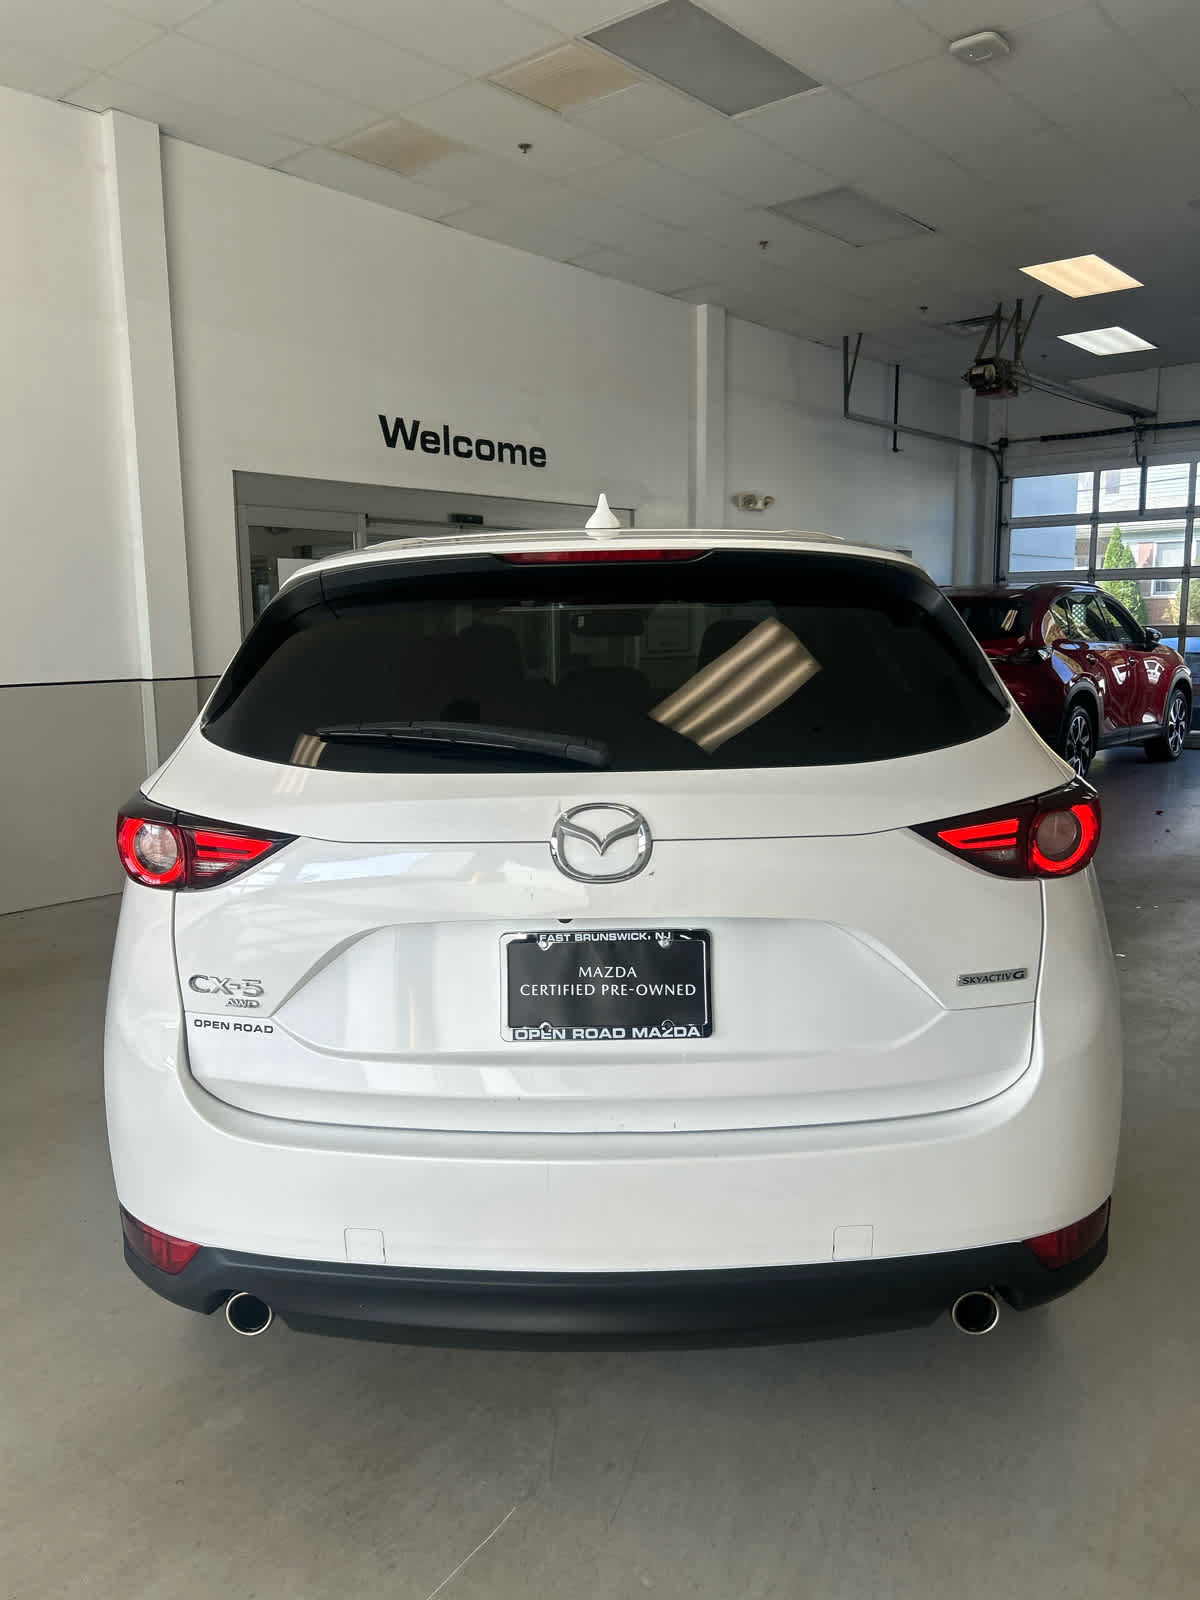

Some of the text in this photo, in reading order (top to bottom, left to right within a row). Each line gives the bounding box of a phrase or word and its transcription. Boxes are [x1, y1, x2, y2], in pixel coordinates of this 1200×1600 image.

[378, 414, 547, 468] Welcome
[655, 931, 671, 941] NJ
[578, 966, 637, 978] MAZDA
[188, 974, 264, 997] CX-5
[520, 983, 697, 997] CERTIFIED PRE-OWNED
[224, 998, 260, 1008] AWD
[194, 1019, 274, 1034] OPEN ROAD
[514, 1025, 702, 1040] OPEN ROAD MAZDA
